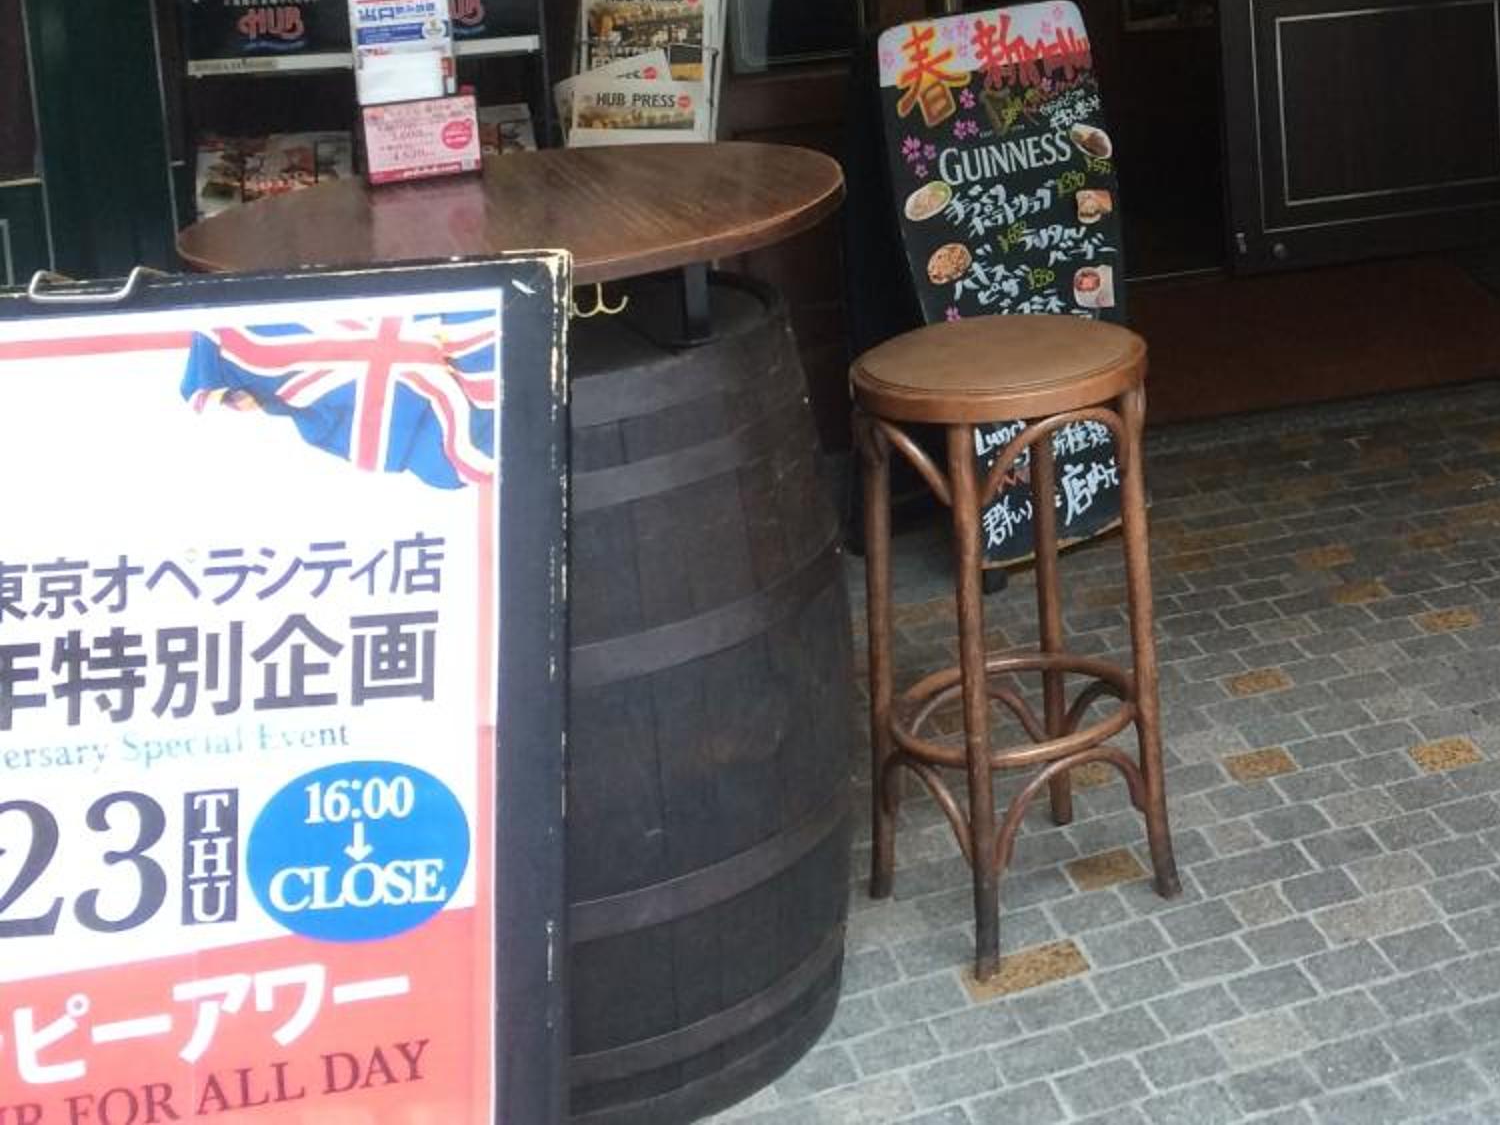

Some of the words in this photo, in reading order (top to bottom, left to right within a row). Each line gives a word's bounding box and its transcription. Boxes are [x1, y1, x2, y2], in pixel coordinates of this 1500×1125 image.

[237, 6, 304, 40] HUB
[596, 92, 626, 108] HUB
[632, 94, 675, 108] PRESS
[939, 127, 1072, 187] GUINNESS
[2, 739, 107, 774] ersary
[121, 726, 244, 769] Special
[257, 722, 351, 751] Event
[303, 775, 416, 825] 16:00
[188, 793, 234, 923] THU
[268, 858, 447, 914] CLOSE
[0, 963, 410, 1084] ピーアワー
[64, 1081, 180, 1125] FOR
[196, 1061, 306, 1115] ALL
[321, 1038, 431, 1094] DAY
